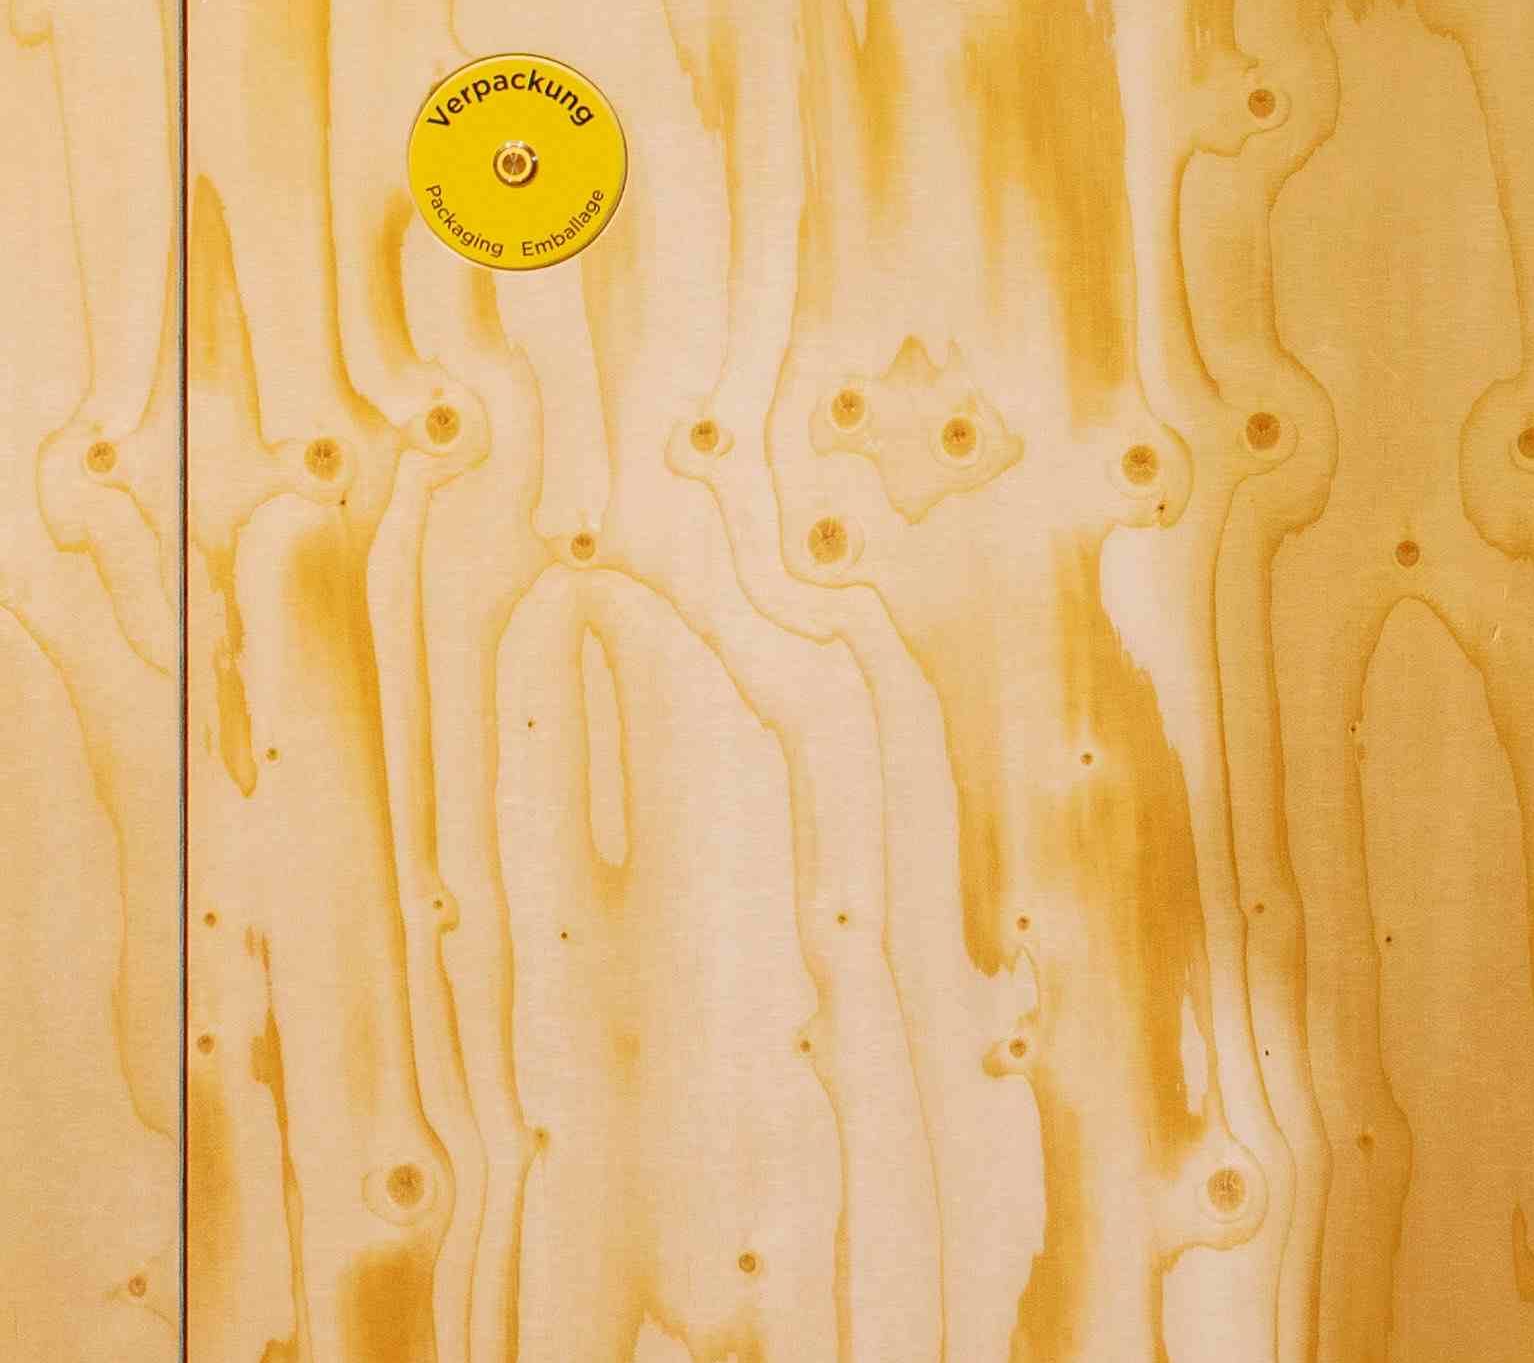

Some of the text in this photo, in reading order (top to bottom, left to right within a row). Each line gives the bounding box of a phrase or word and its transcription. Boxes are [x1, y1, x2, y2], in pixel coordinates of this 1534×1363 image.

[427, 69, 594, 128] Verpackung
[426, 185, 605, 258] Packaging Emballage
